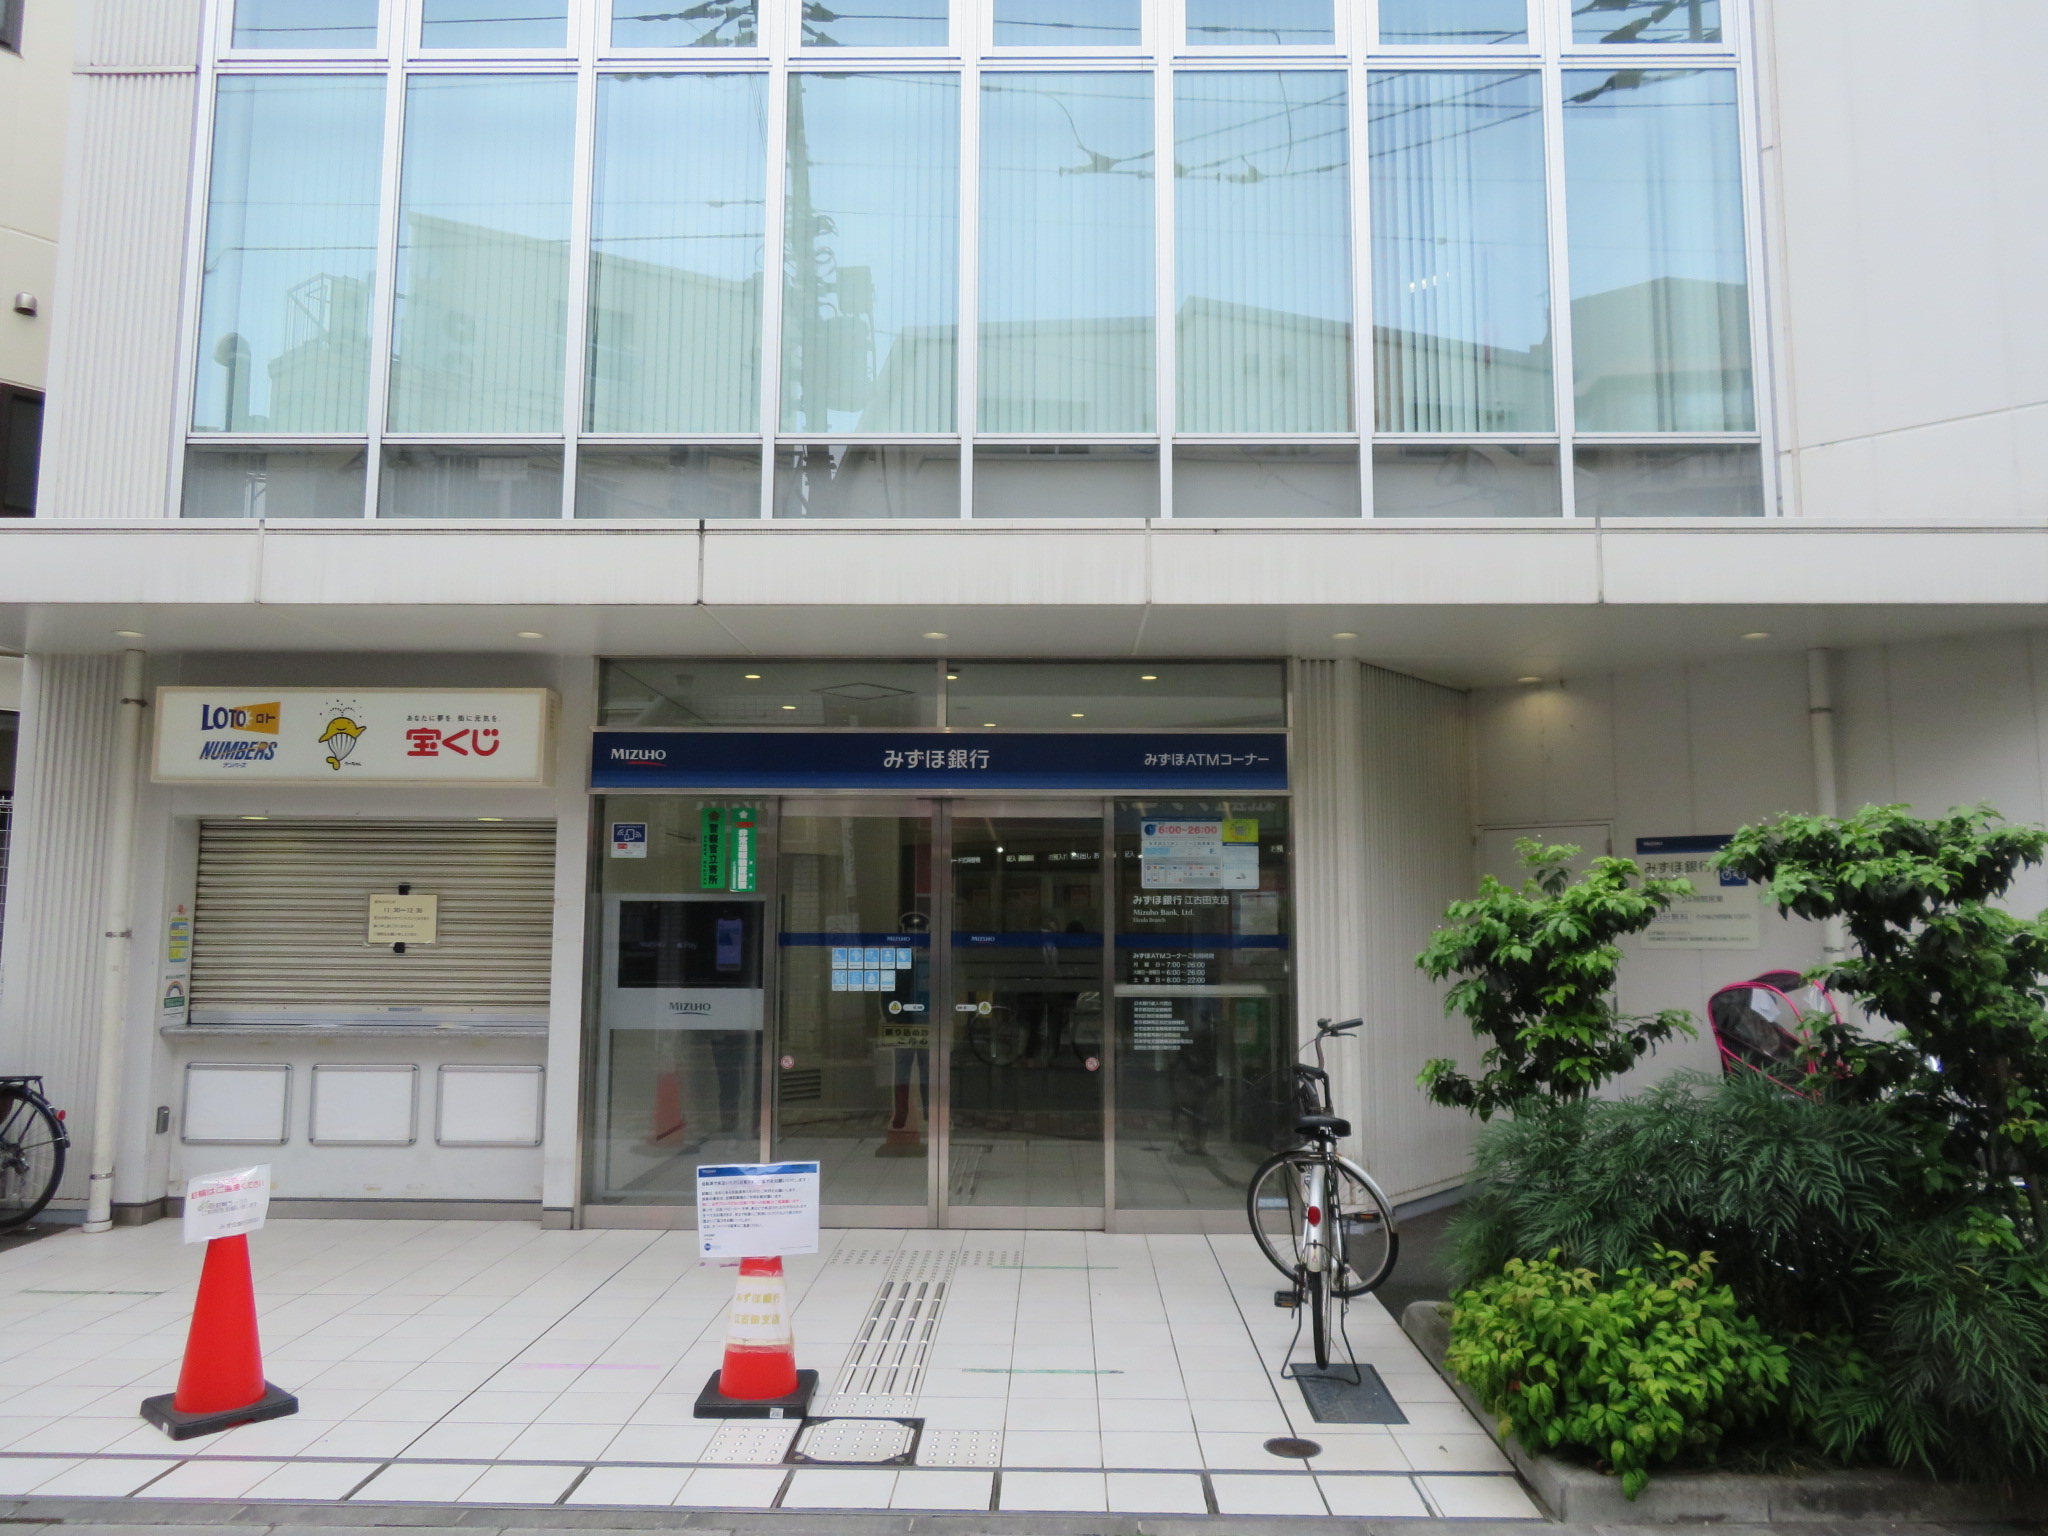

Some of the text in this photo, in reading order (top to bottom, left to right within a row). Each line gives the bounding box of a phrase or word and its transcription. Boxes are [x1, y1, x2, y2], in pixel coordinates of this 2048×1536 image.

[201, 704, 246, 731] LOTO
[256, 713, 276, 724] ロト
[406, 727, 500, 757] 宝くじ
[200, 741, 278, 760] NUMBERS
[611, 748, 667, 760] MIZUHO
[883, 749, 990, 769] みずほ銀行
[1144, 752, 1270, 766] みずほATMコーナー
[1644, 861, 1711, 873] みずほ銀行
[1133, 896, 1230, 906] みずほ銀行 江古田支店
[1160, 909, 1180, 917] Bank,
[669, 1002, 711, 1011] MIZUHO
[734, 1313, 780, 1325] 江古田支店
